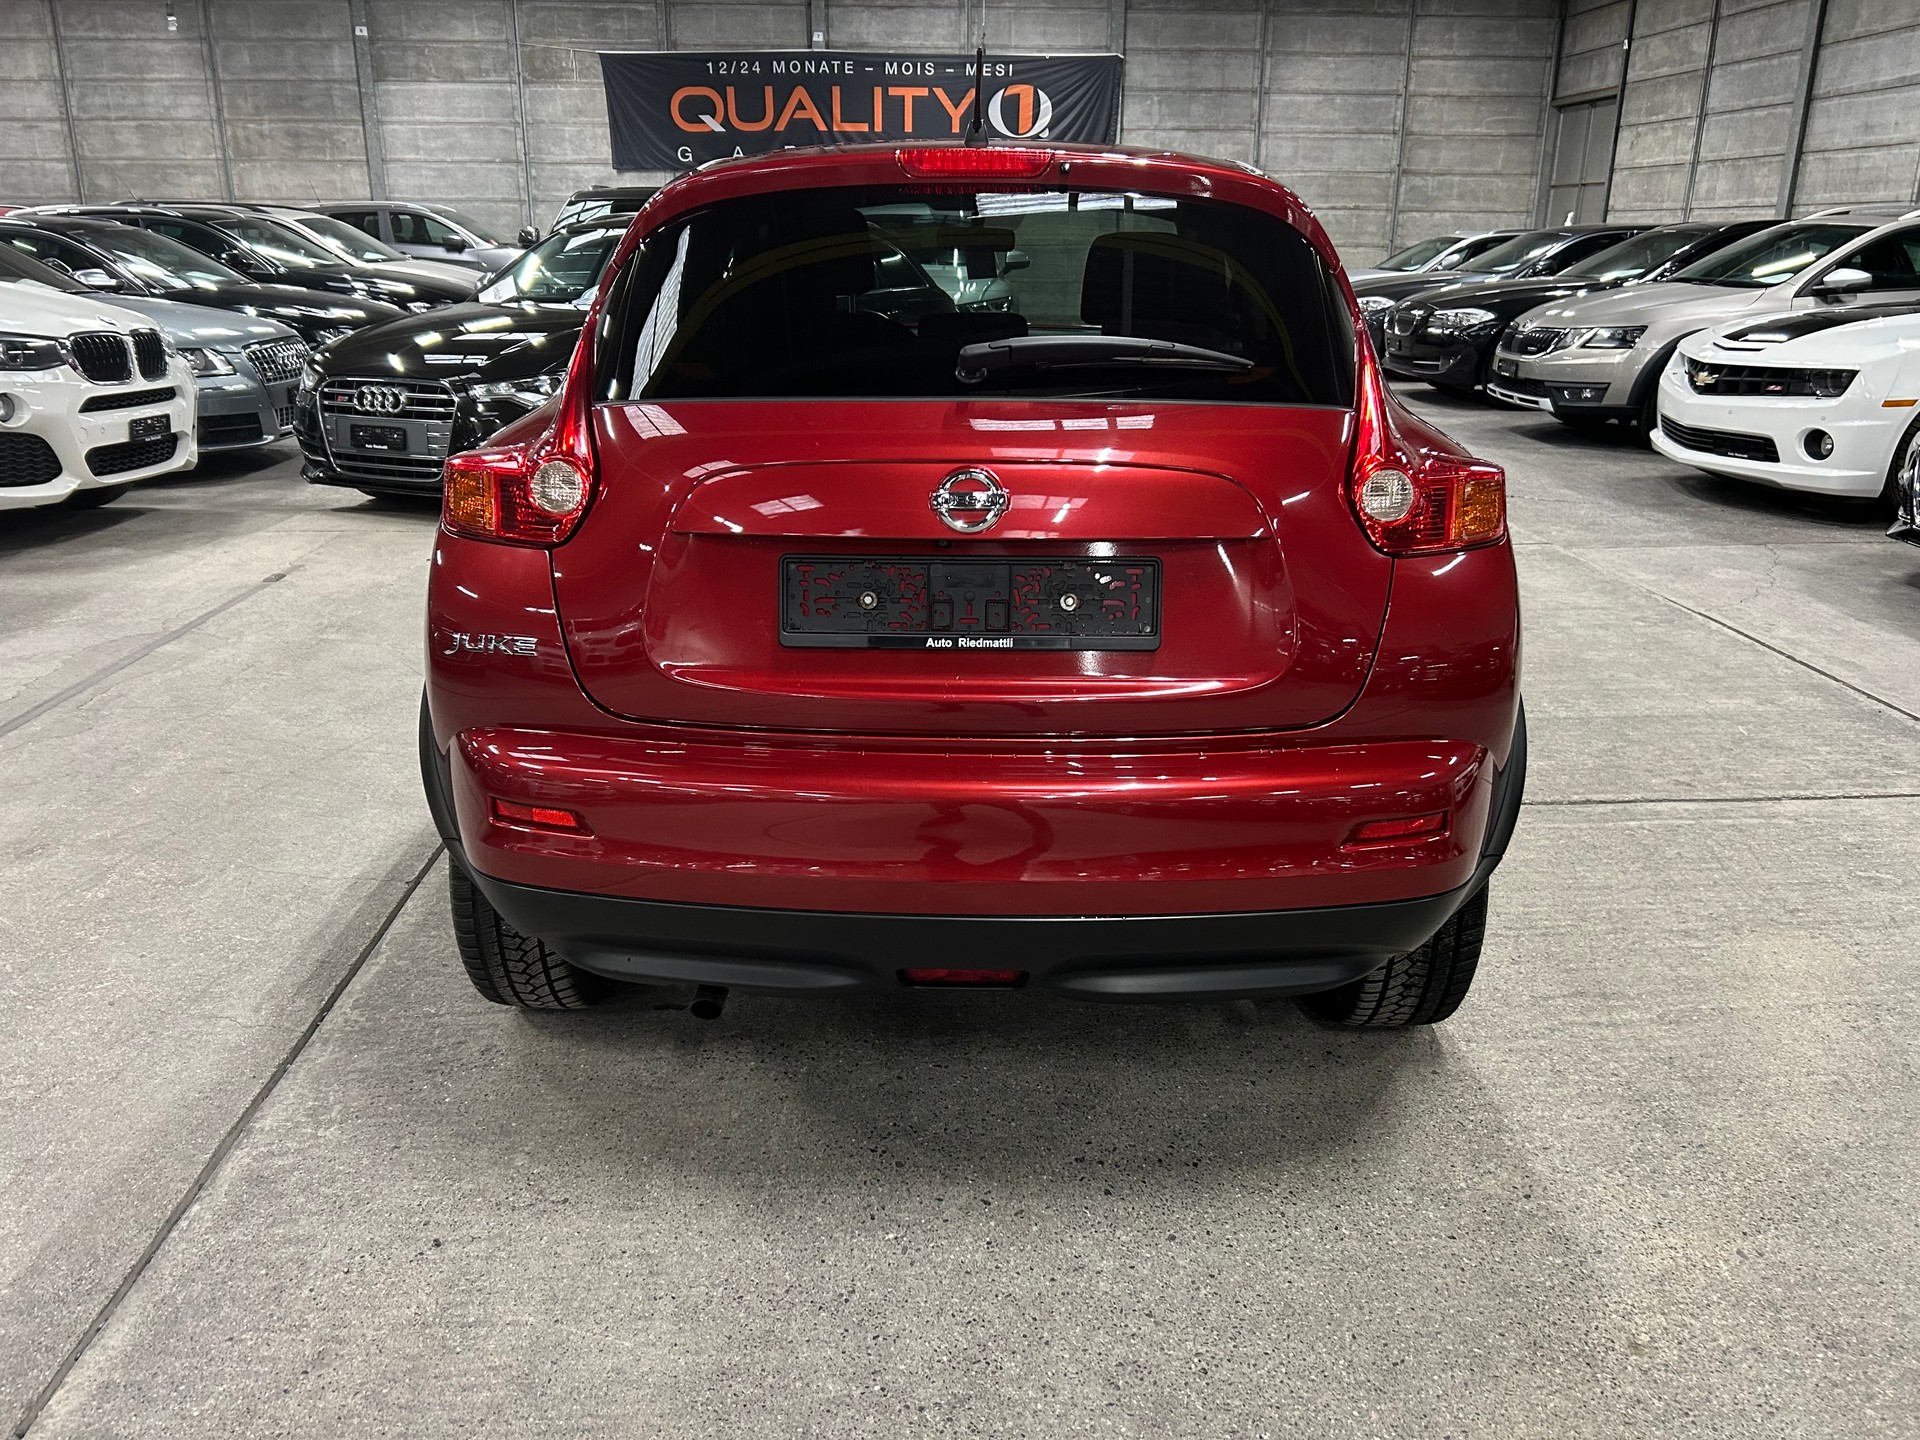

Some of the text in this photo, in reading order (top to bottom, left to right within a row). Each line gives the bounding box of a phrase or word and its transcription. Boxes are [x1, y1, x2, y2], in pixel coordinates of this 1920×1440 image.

[706, 60, 761, 75] 12/24
[772, 60, 855, 75] MONATE
[884, 61, 935, 76] MOIS
[965, 63, 1013, 77] MESI
[670, 85, 976, 134] QUALITY
[443, 632, 538, 657] JUKE
[925, 637, 953, 648] Auto
